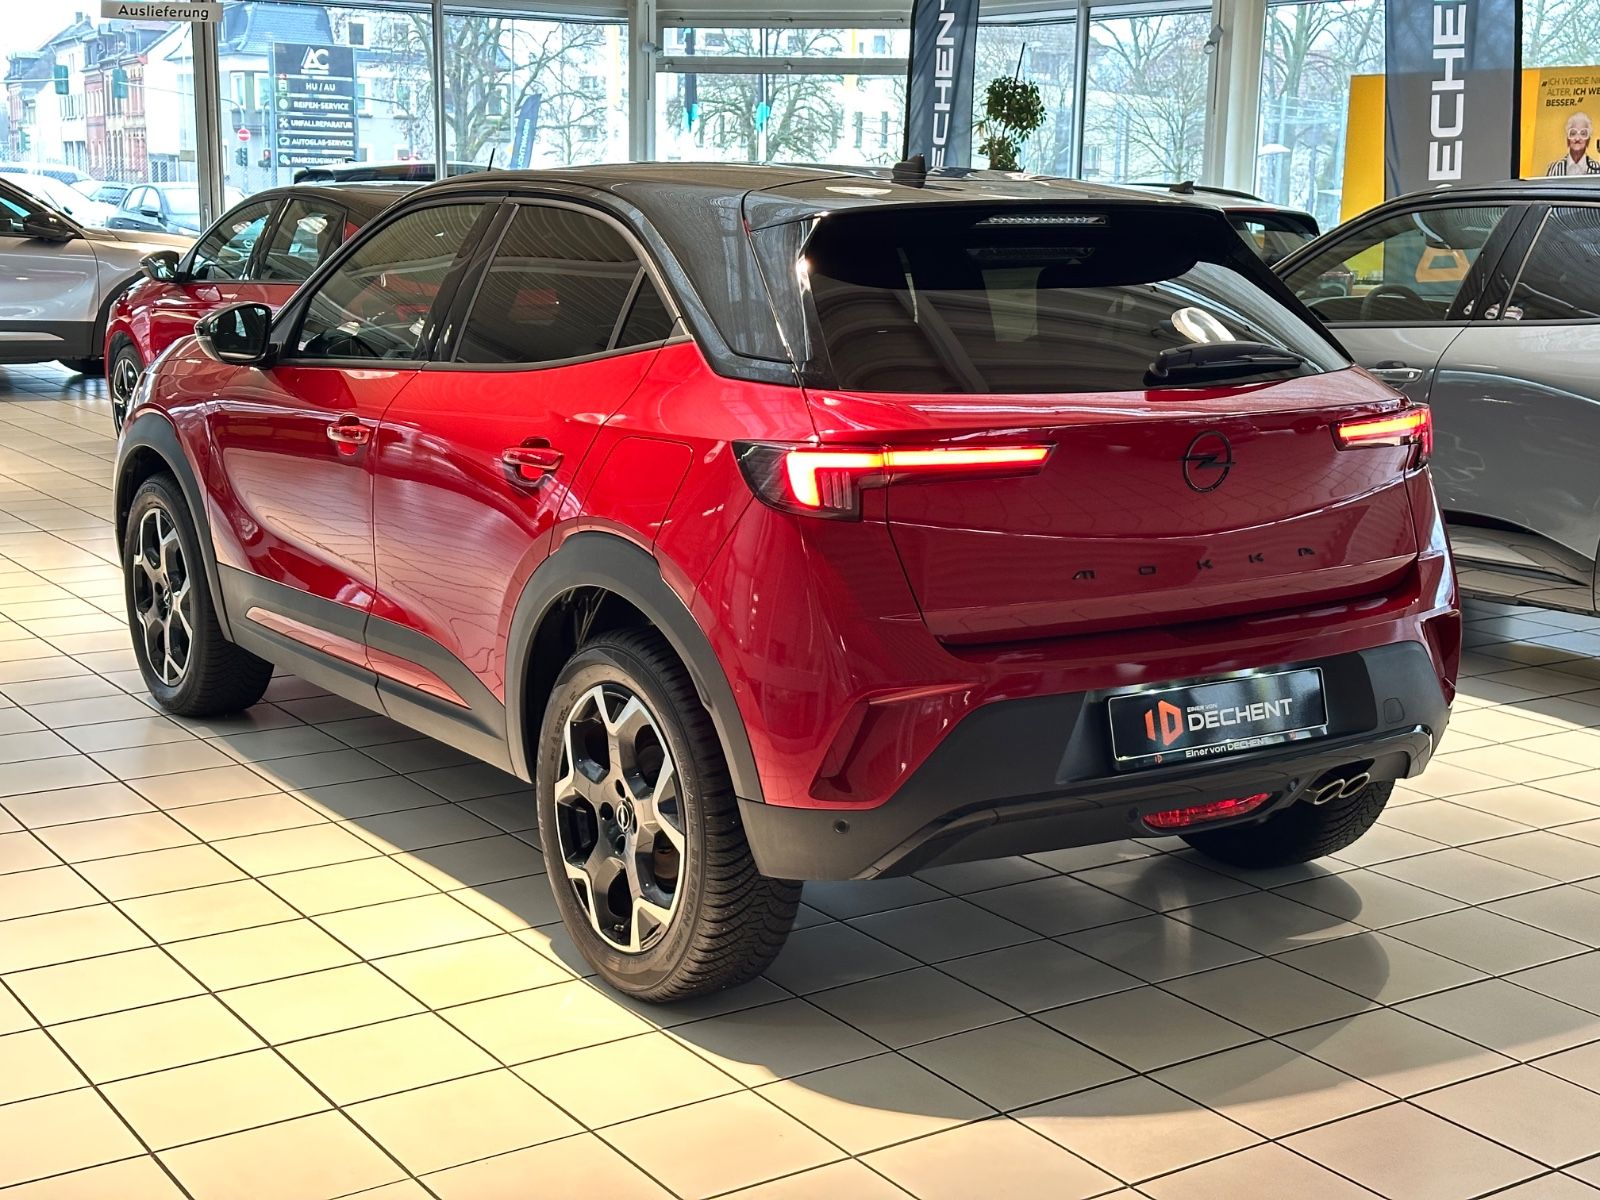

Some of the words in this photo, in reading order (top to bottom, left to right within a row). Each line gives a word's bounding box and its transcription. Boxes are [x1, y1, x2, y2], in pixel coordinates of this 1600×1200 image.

[118, 4, 209, 20] Auslieferung
[931, 0, 955, 167] ECHEN
[1561, 76, 1589, 85] WERDE
[306, 82, 318, 91] HU
[324, 83, 336, 92] AU
[1428, 0, 1467, 183] ECHE
[1573, 87, 1586, 96] ICH
[293, 101, 349, 110] REIFEN-SERVICE
[290, 120, 353, 129] UNFALLREPARATUR
[291, 138, 353, 147] AUTOGLAS-SERVICE
[1187, 698, 1293, 732] DECHENT
[1209, 745, 1227, 754] von
